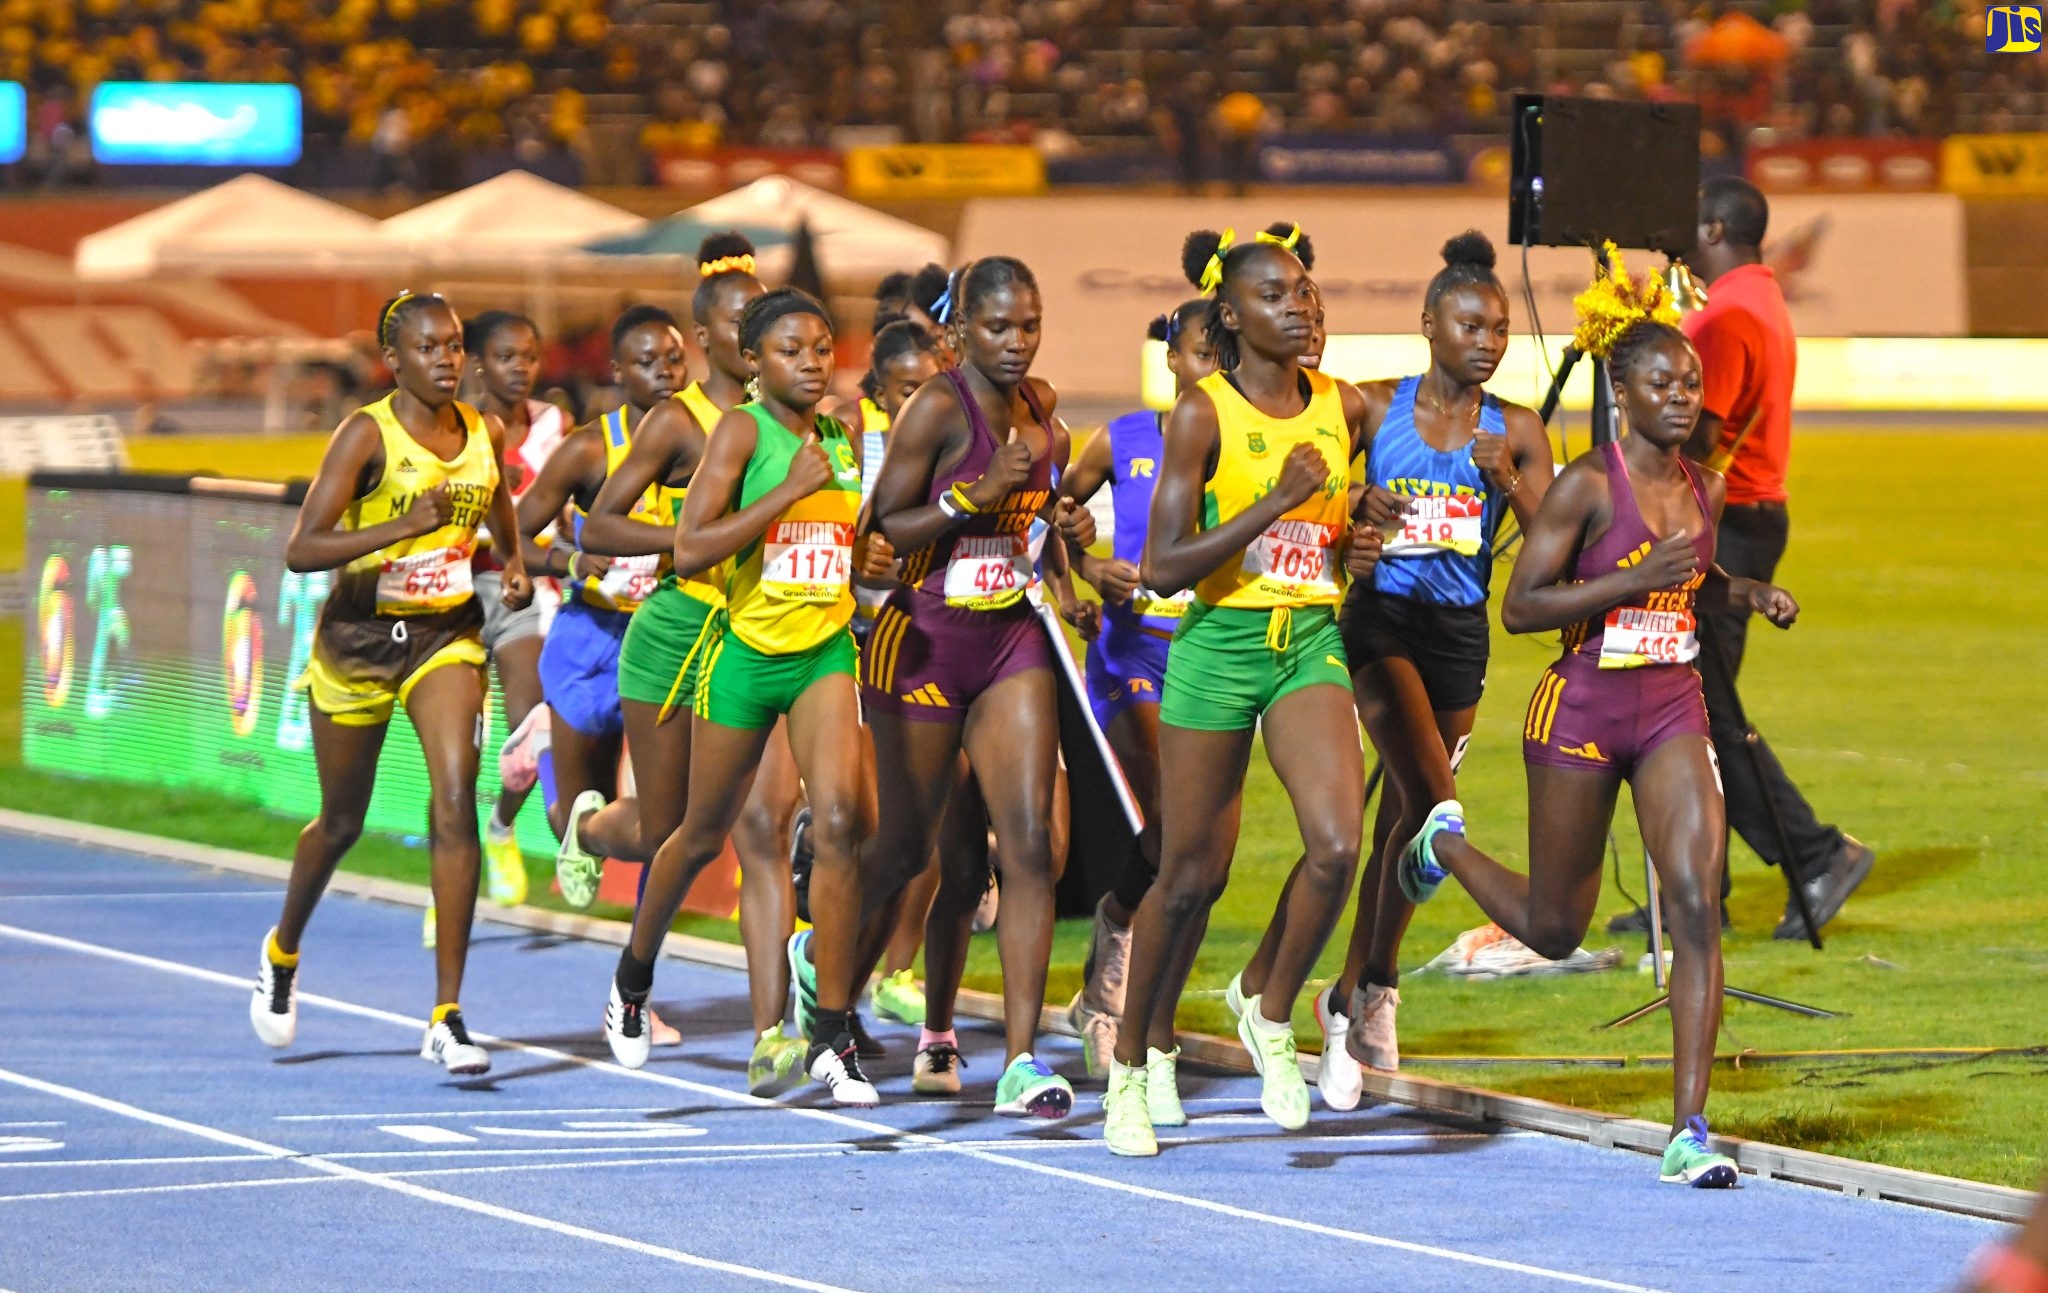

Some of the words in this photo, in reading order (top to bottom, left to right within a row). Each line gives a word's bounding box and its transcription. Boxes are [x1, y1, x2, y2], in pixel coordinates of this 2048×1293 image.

[776, 522, 836, 545] PUMA
[956, 537, 1013, 559] PUMA
[788, 548, 844, 579] 1174
[1270, 543, 1324, 581] 1059
[405, 569, 448, 596] 670
[974, 560, 1015, 592] 426
[1646, 591, 1688, 611] TECH
[1617, 608, 1678, 632] PUMA
